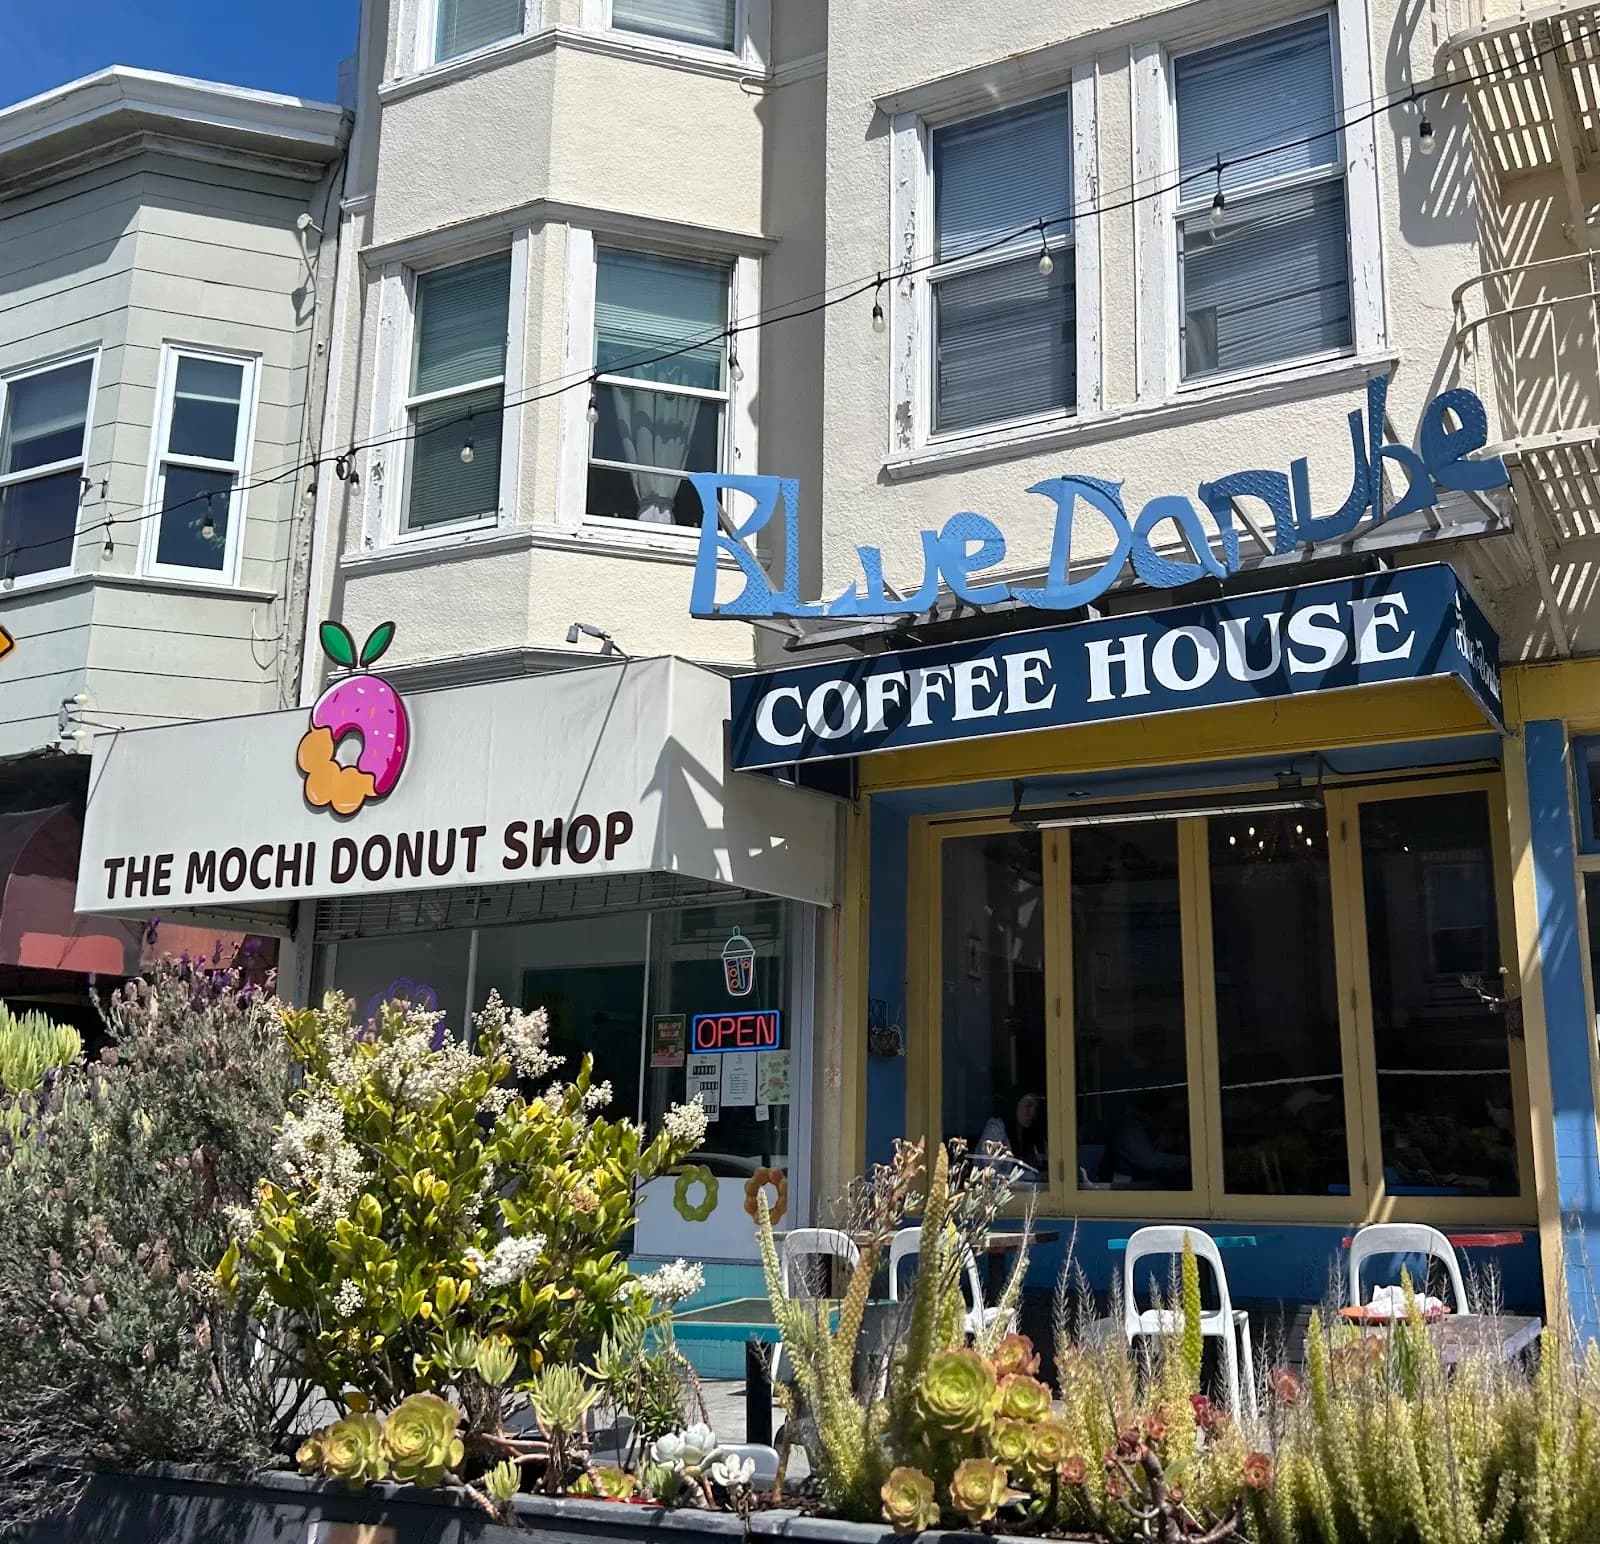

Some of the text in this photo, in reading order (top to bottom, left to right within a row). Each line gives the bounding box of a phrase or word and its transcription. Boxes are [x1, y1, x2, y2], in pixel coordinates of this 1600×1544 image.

[689, 375, 1510, 619] Blue Danube
[755, 592, 1416, 746] COFFEE HOUSE
[104, 811, 634, 900] THE MOCHI DONUT SHOP
[696, 1014, 775, 1049] OPEN
